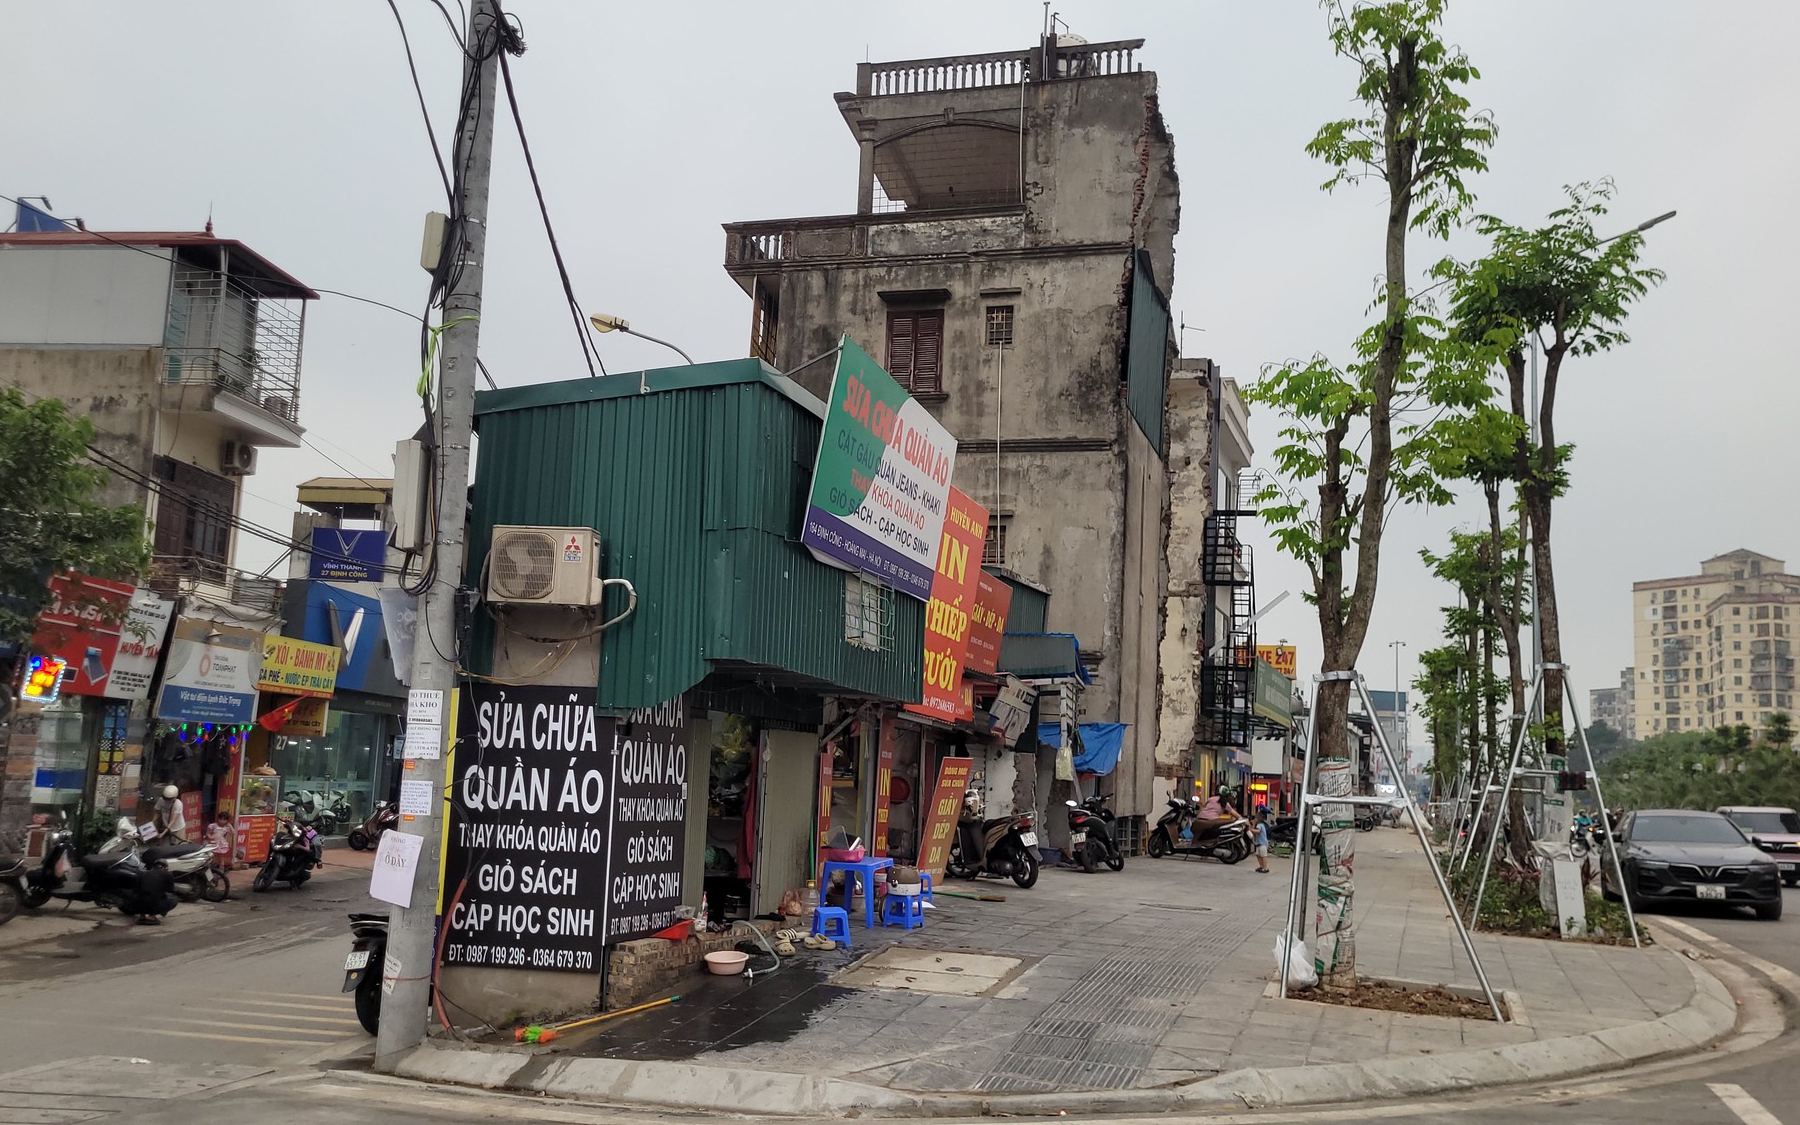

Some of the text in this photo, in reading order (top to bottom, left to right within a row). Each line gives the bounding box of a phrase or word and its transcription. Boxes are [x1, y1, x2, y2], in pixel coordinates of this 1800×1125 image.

[932, 447, 949, 486] ÁO
[851, 469, 874, 495] THAY
[871, 483, 893, 512] KHÓA
[914, 507, 925, 530] ÁO
[895, 473, 919, 501] JEANS
[922, 489, 941, 516] KHAKI
[848, 499, 873, 526] SÁCH
[896, 528, 912, 549] HỌC
[912, 537, 929, 557] SINH
[970, 521, 984, 540] ANH
[938, 531, 969, 586] IN
[275, 642, 290, 665] XÔI
[294, 644, 315, 669] BÁNH
[1275, 651, 1294, 665] 247
[268, 669, 281, 682] PHÊ
[478, 692, 525, 748] SỬA
[532, 694, 597, 752] CHỮA
[276, 735, 288, 750] 27
[621, 732, 685, 786] QUẦN ÁO
[463, 756, 550, 812] QUẦN
[557, 757, 604, 814] ÁO
[880, 768, 891, 796] IN
[619, 791, 684, 823] THAY KHÓA QUẦN ÁO
[822, 786, 831, 817] IN
[460, 819, 600, 854] THAY KHÓA QUẦN ÁO
[627, 829, 673, 863] GIỎ SÁCH
[933, 820, 950, 839] DÉP
[929, 846, 941, 863] DA
[479, 858, 577, 895] GIỎ SÁCH
[613, 872, 680, 910] CẶP HỌC SINH
[452, 899, 594, 939] CẶP HỌC SINH
[611, 918, 619, 935] ĐT:
[620, 916, 631, 934] 0987
[632, 915, 640, 932] 199
[640, 914, 648, 931] 296
[652, 912, 662, 929] 0364
[663, 911, 671, 928] 679
[449, 944, 463, 961] ĐT:
[466, 945, 488, 963] 0987
[491, 946, 506, 964] 199
[508, 947, 524, 965] 296
[533, 948, 554, 967] 0364
[557, 950, 573, 968] 679
[576, 951, 592, 969] 370
